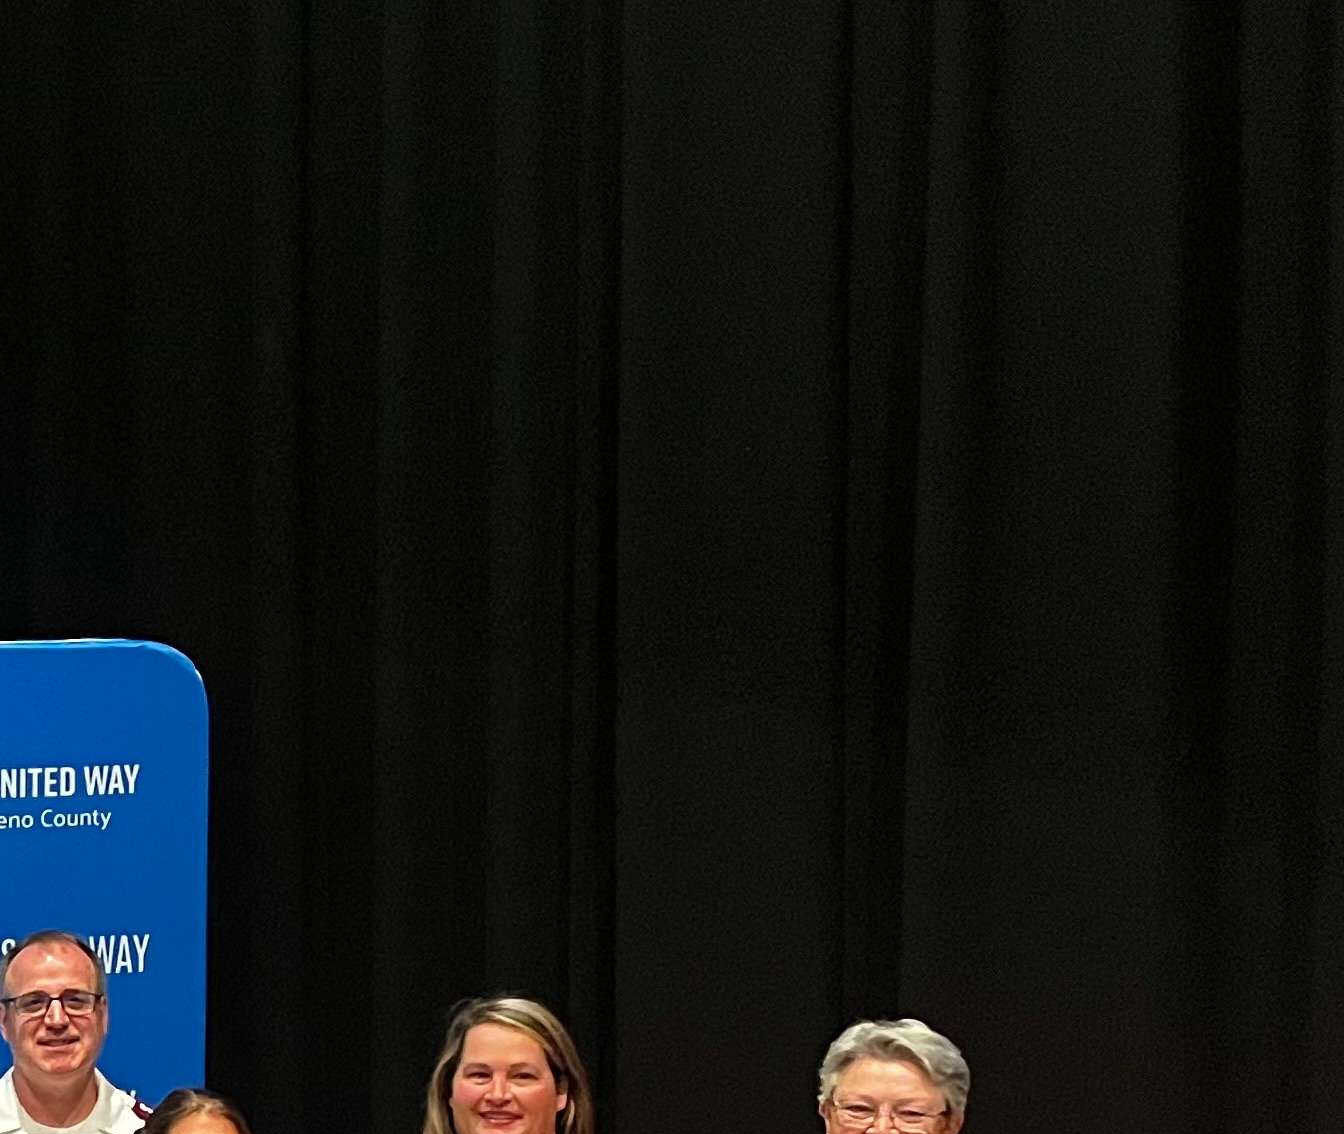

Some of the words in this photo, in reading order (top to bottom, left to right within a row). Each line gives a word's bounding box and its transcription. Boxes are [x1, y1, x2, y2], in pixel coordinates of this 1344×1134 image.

[83, 763, 140, 796] WAY
[40, 809, 112, 831] County
[88, 933, 151, 975] WAY
